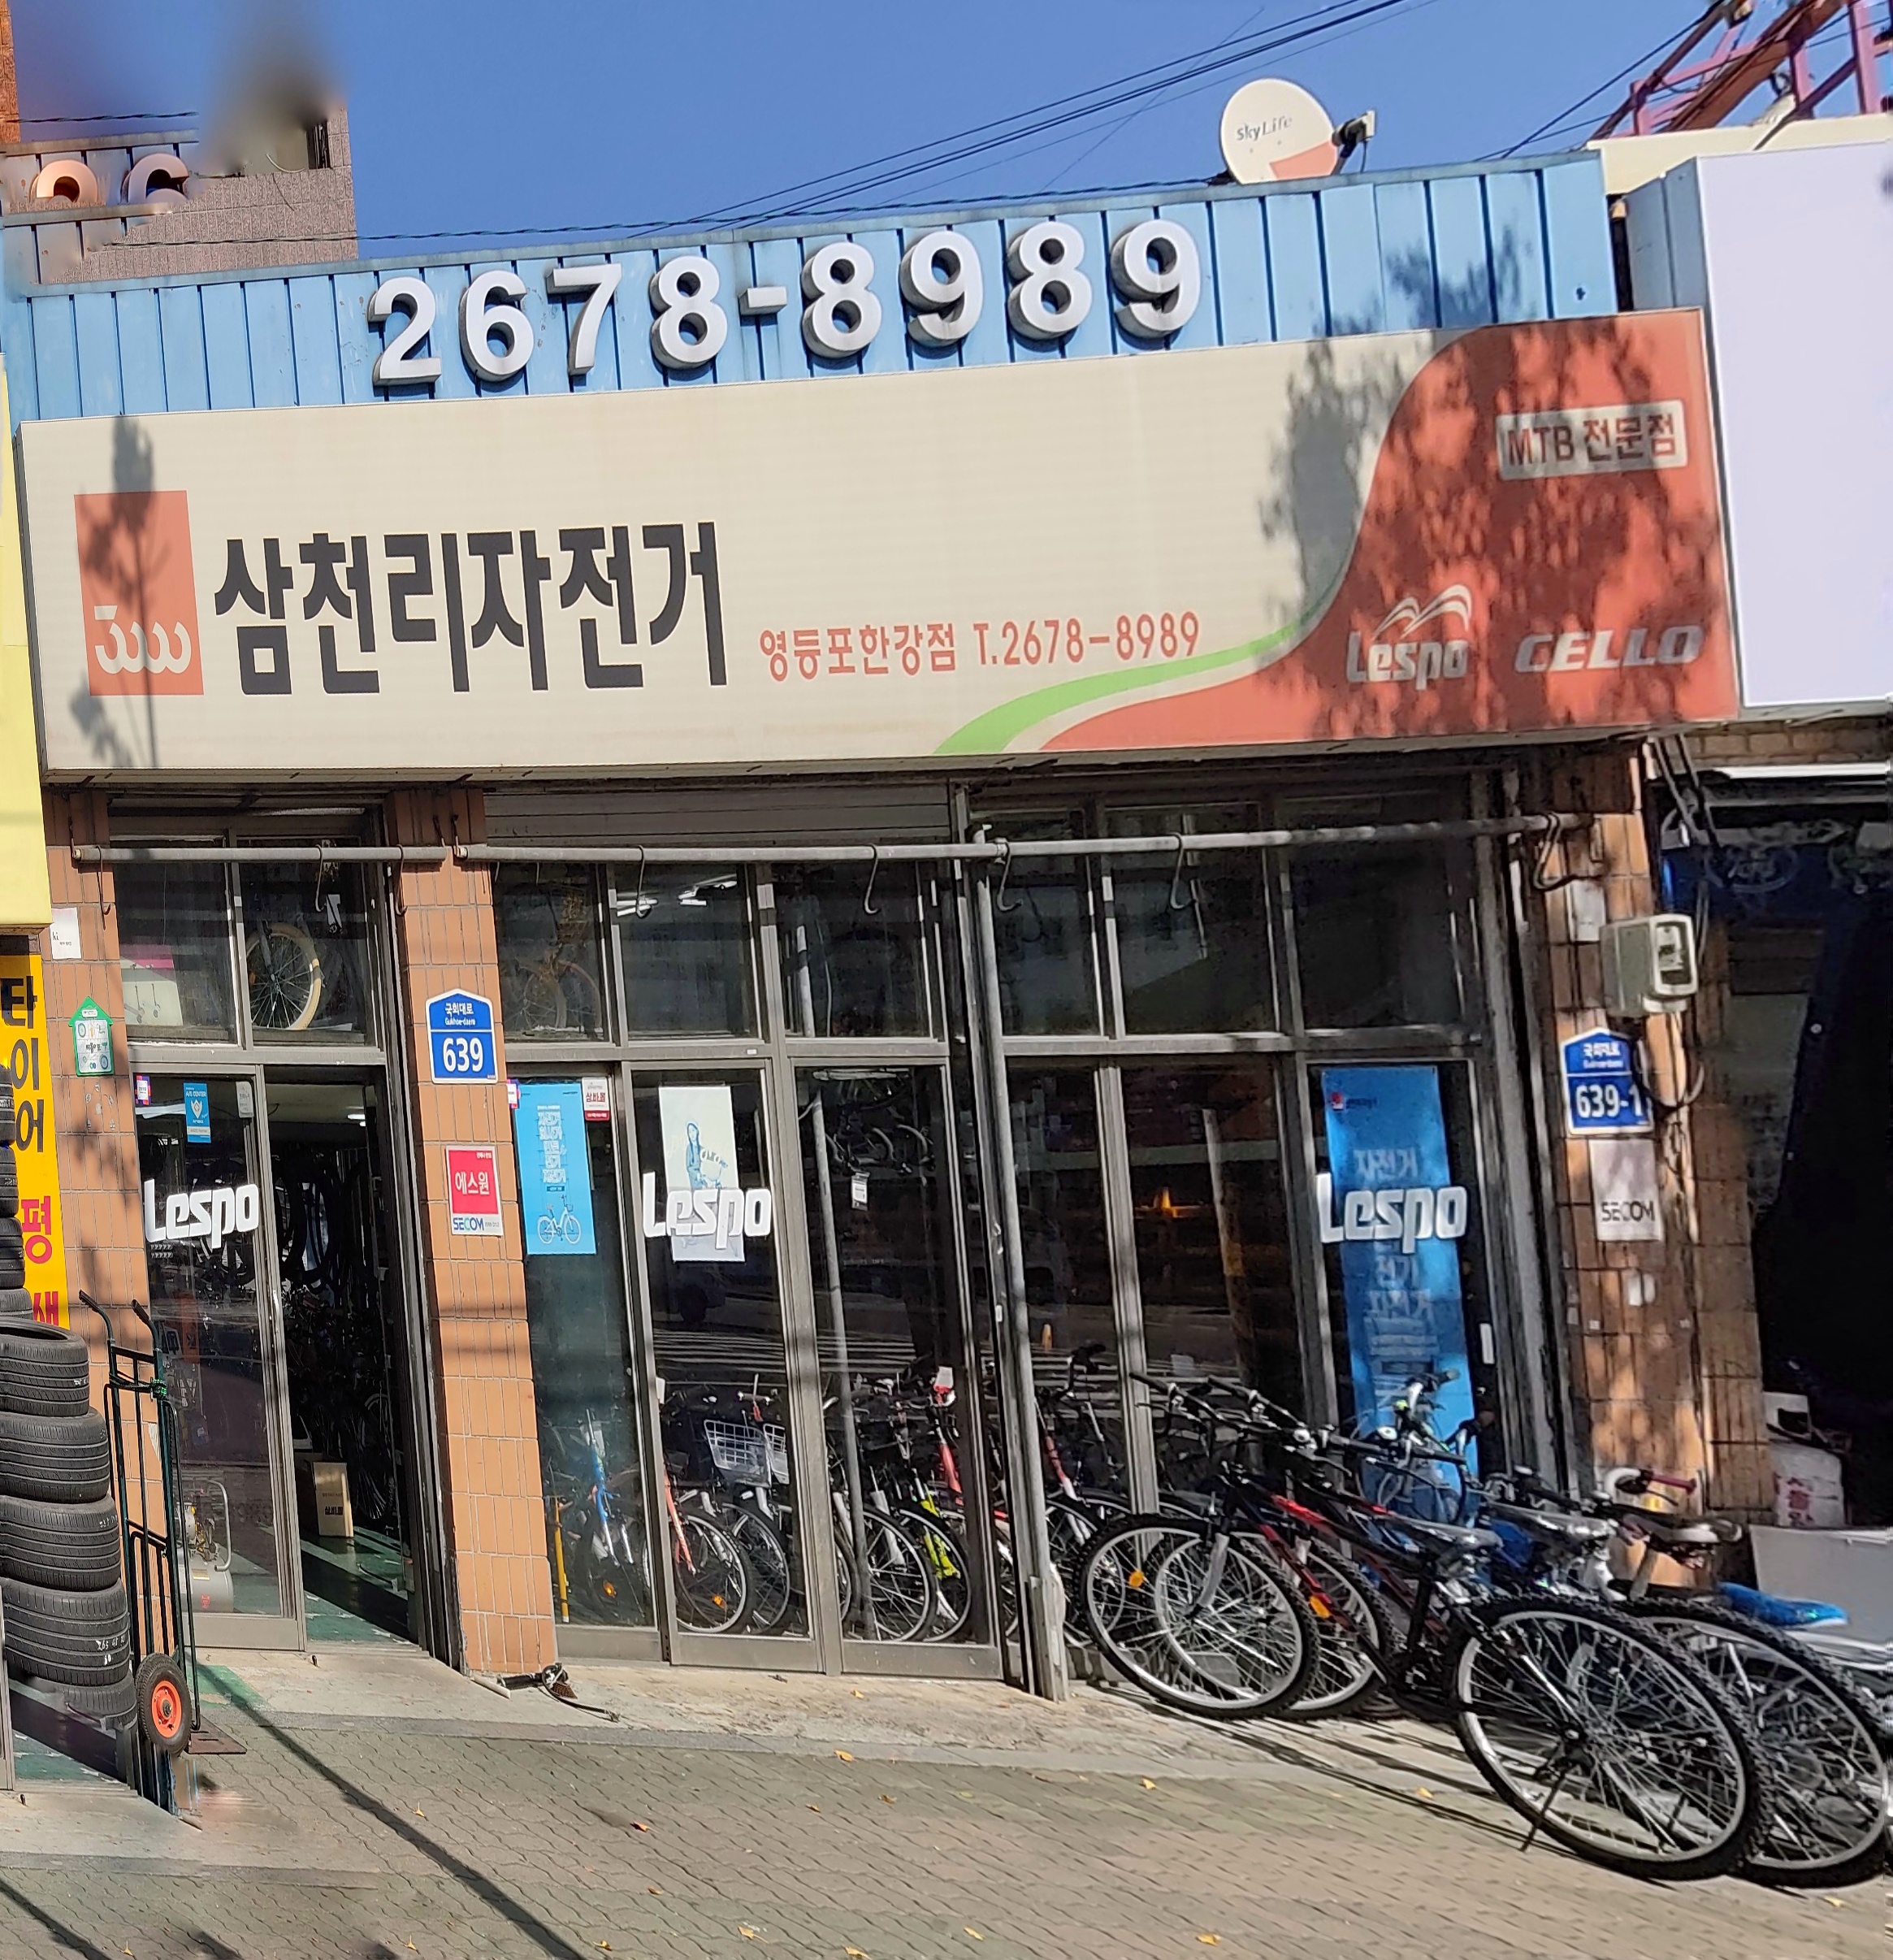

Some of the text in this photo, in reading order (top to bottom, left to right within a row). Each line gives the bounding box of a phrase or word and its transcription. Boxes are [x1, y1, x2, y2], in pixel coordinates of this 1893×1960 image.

[368, 219, 1203, 388] 2678-8989
[1508, 414, 1676, 466] MTB 전문점
[214, 522, 727, 696] 삼천리자전거
[760, 610, 1201, 683] 영등포한강점 T.2678-8989
[1346, 631, 1469, 692] Lespo
[1514, 624, 1705, 674] CELLO
[445, 1002, 474, 1017] 국회대로
[0, 975, 45, 1153] 타이어
[443, 1037, 484, 1073] 639
[1575, 1083, 1644, 1118] 639-1
[455, 1171, 490, 1195] 에스원
[643, 1171, 772, 1250] Lespo
[144, 1178, 259, 1249] Lespo
[453, 1217, 485, 1231] SECOM
[1315, 1172, 1468, 1255] Lespo
[1601, 1201, 1656, 1222] SECOM
